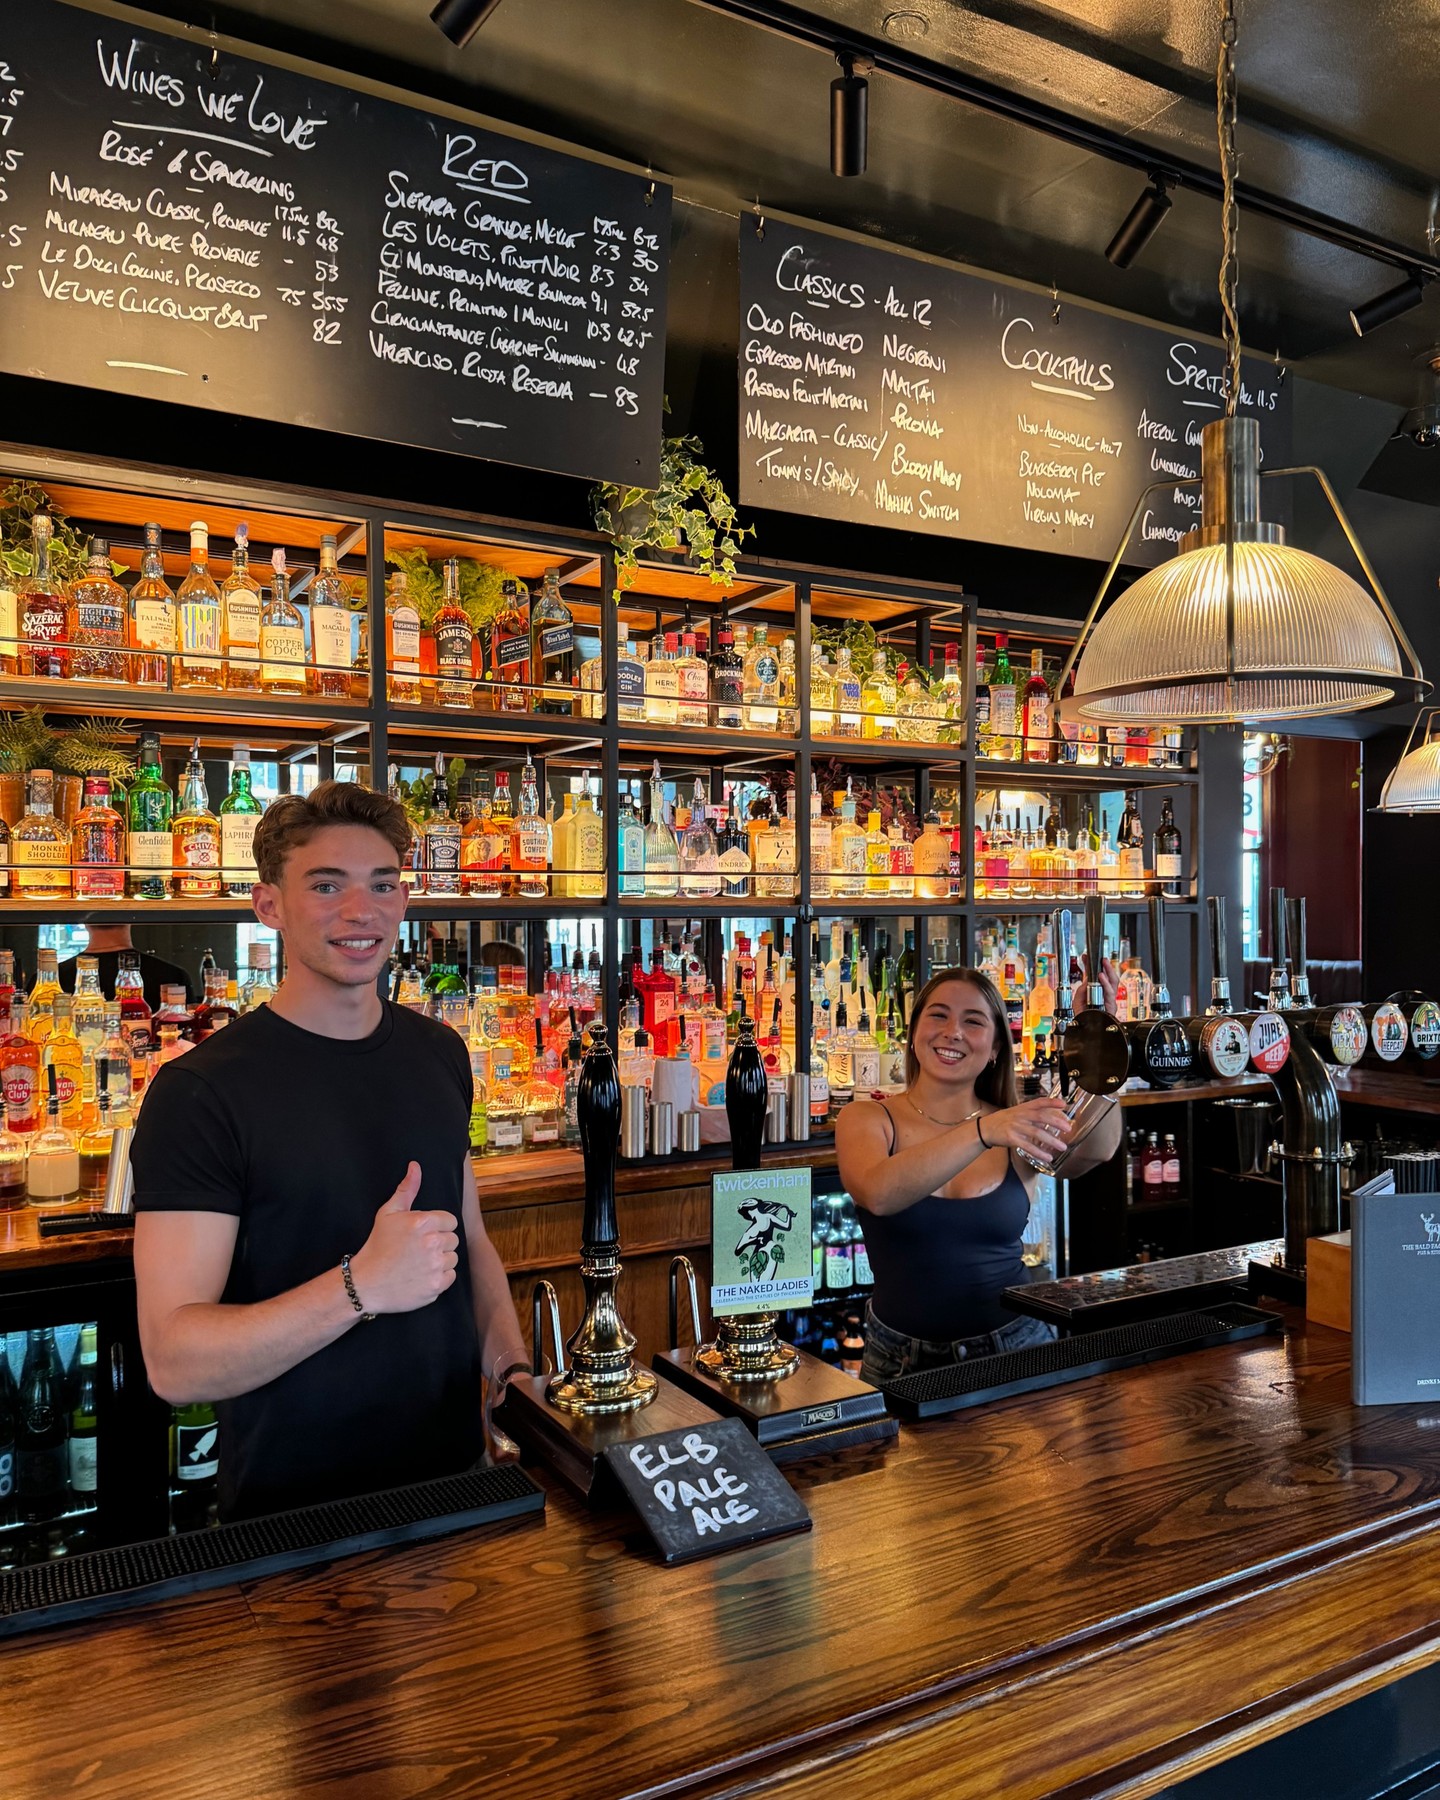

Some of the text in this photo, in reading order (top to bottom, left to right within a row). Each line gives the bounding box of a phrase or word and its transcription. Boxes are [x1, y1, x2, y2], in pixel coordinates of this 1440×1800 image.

[97, 38, 328, 150] WINES WE LOVE
[441, 133, 528, 190] RED
[385, 170, 456, 220] SIERRA
[382, 211, 417, 243] LES
[132, 222, 184, 253] PURE
[316, 260, 339, 282] 53
[316, 233, 338, 252] 48
[41, 241, 67, 263] LE
[185, 263, 261, 298] PROSECCO
[632, 249, 659, 272] 30
[776, 245, 866, 309] CLASSICS
[38, 269, 114, 308] VEUVE
[119, 287, 217, 321] CLICQUOT
[313, 318, 342, 345] 82
[747, 303, 863, 354] OLD FASHIONED
[616, 353, 640, 376] 48
[745, 339, 856, 379] ESPRESSO MARTINI
[883, 334, 946, 373] NEGRONI
[1001, 317, 1115, 391] COCKTAILS
[462, 351, 506, 385] RIOJA
[512, 363, 573, 401] RESERVA
[615, 386, 639, 415] 83
[744, 368, 790, 400] PASSION
[745, 410, 818, 445] MARGARITA
[1137, 408, 1178, 442] APEROL
[1081, 462, 1105, 487] PIE
[22, 611, 64, 631] SAZERAC
[79, 608, 123, 619] HIGHLAND
[79, 615, 101, 623] PARK
[230, 604, 259, 614] BUSHMILLS
[265, 639, 303, 651] COPPER
[335, 638, 344, 646] 12
[439, 629, 472, 642] JAMESON
[274, 646, 297, 656] DOG
[189, 842, 218, 851] CHIVAS
[78, 876, 88, 885] 12
[660, 999, 669, 1007] 24
[1151, 1055, 1193, 1067] GUINNESS
[8, 1090, 27, 1098] Club
[715, 1173, 809, 1193] twickenham
[716, 1280, 809, 1297] THE NAKED LADIES
[629, 1433, 719, 1479] ELB
[653, 1467, 749, 1512] PALE
[691, 1499, 759, 1536] ALE
